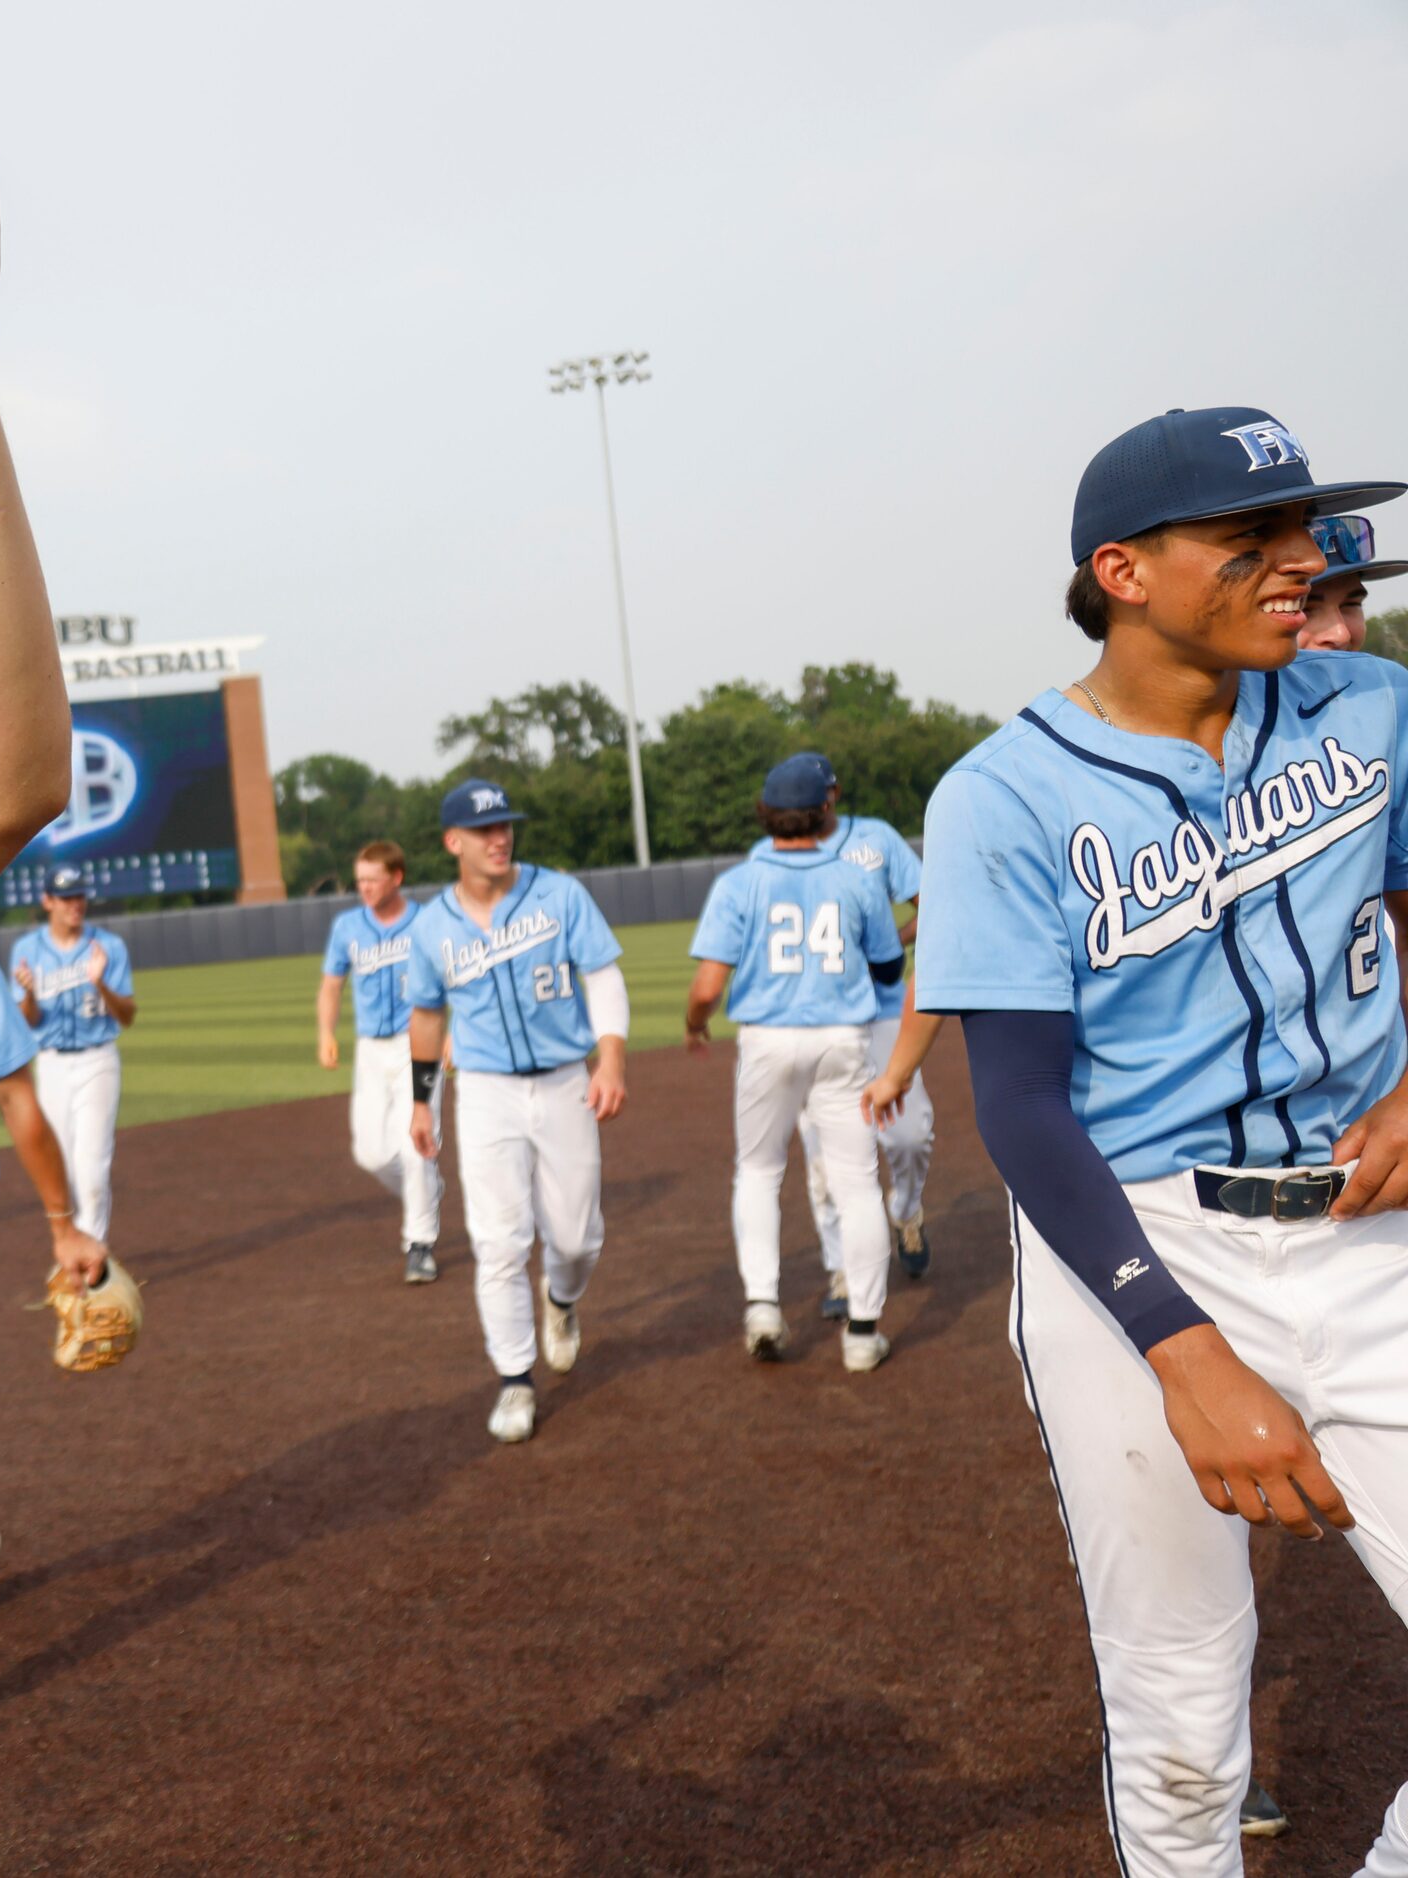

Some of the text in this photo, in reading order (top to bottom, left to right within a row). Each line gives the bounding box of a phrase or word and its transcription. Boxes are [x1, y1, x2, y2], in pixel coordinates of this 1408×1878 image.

[73, 650, 234, 682] BASEBALL
[1069, 737, 1390, 971] Jaguars
[348, 934, 412, 976] Jaguar
[441, 908, 561, 990] Jaguars
[769, 901, 845, 974] 24
[532, 961, 575, 1003] 21
